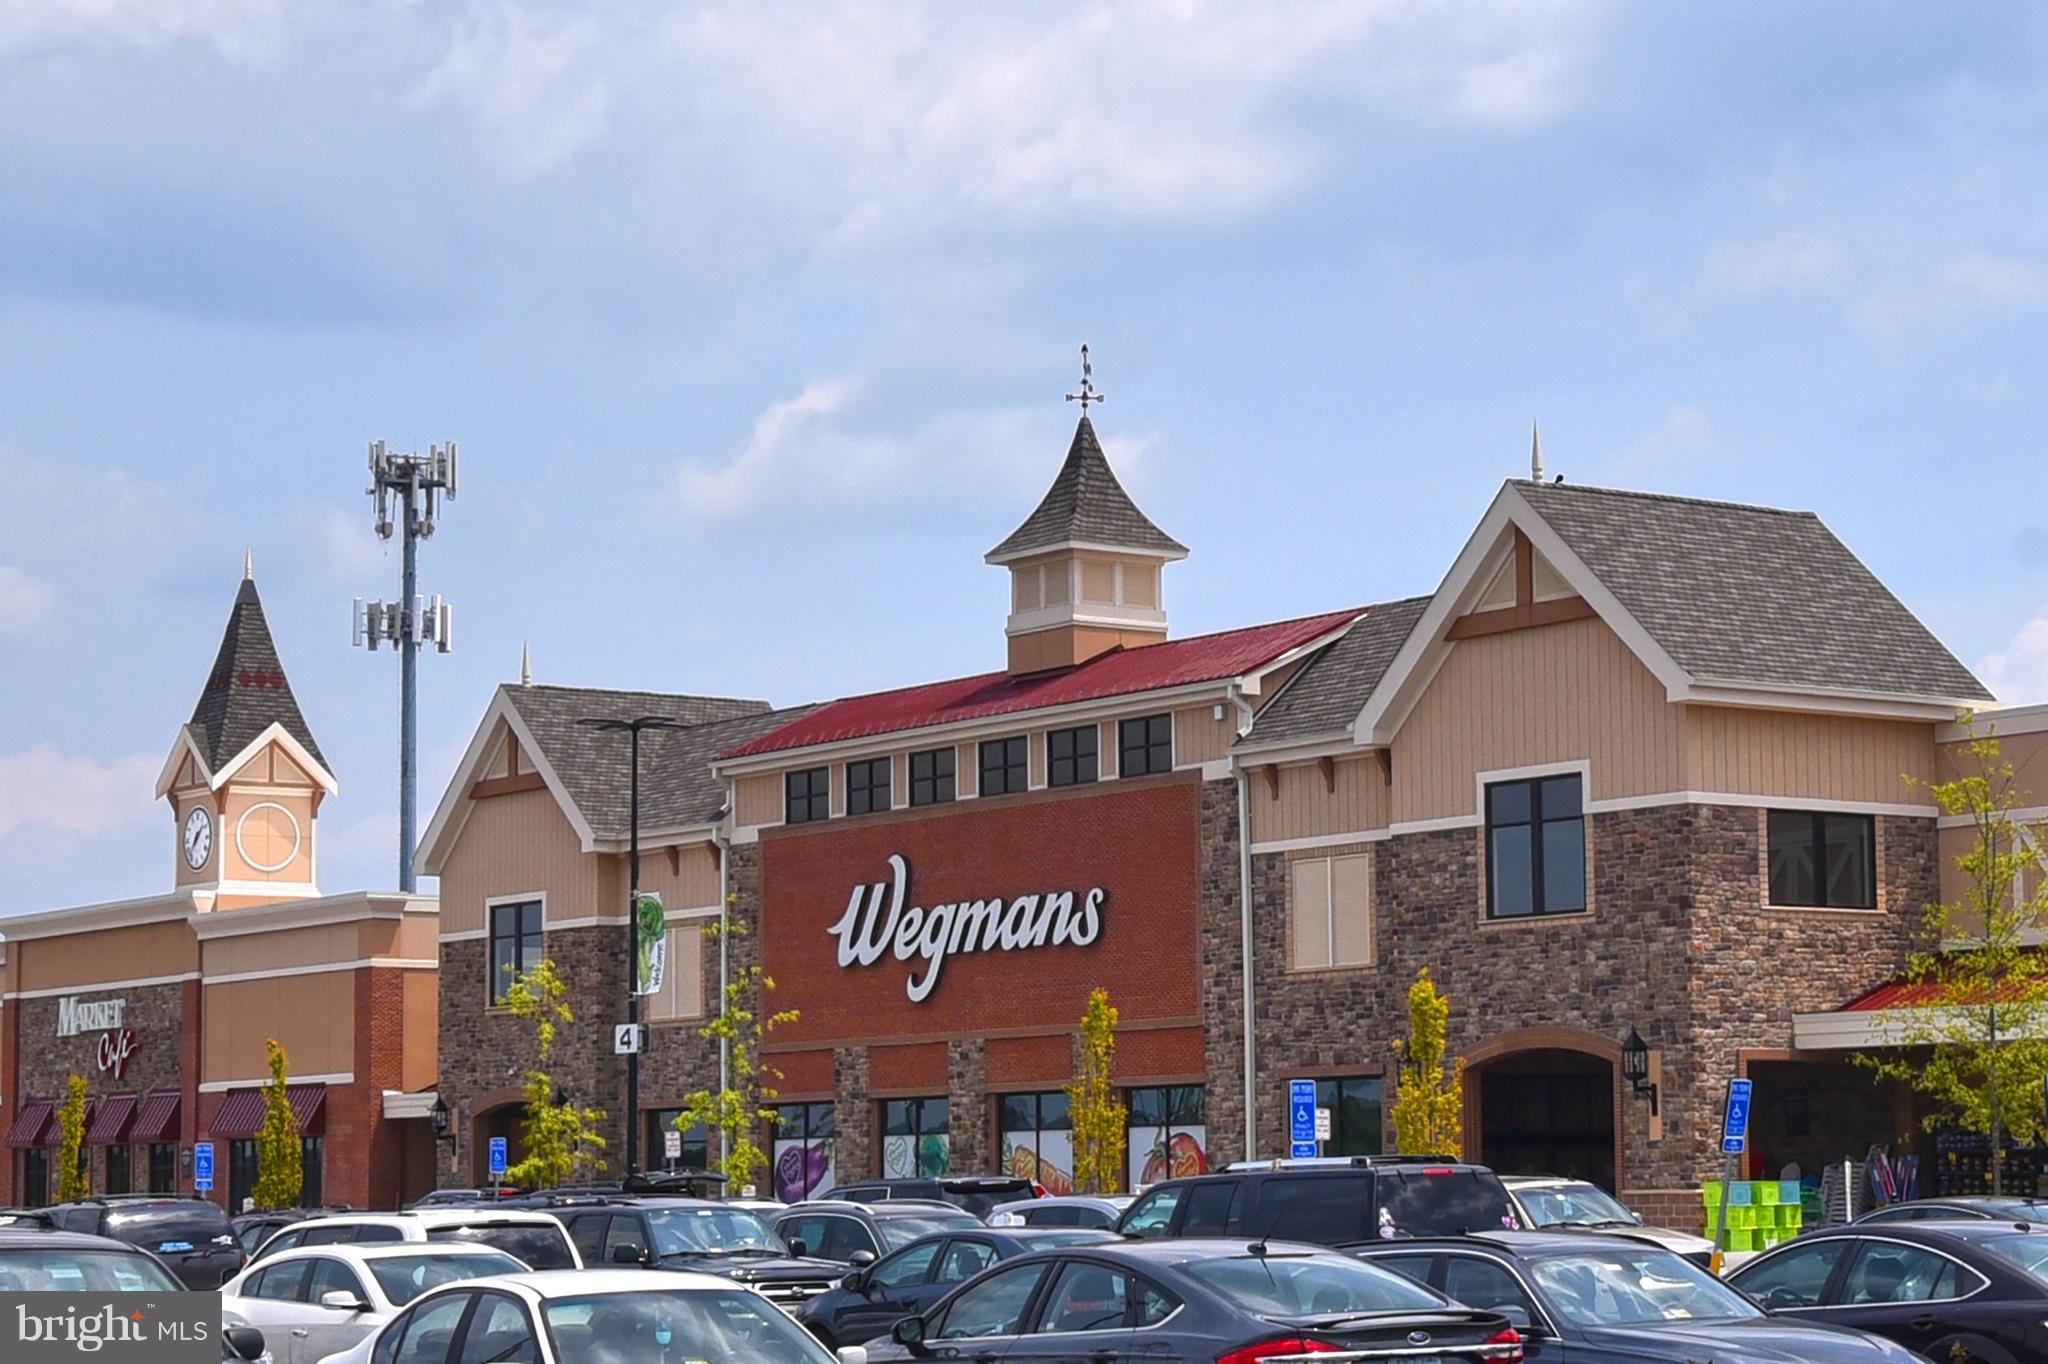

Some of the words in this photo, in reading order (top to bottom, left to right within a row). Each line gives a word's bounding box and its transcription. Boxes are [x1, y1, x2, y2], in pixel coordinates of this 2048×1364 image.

[826, 854, 1104, 1002] Wegmans
[56, 996, 126, 1037] MARKET
[619, 1027, 633, 1050] 4
